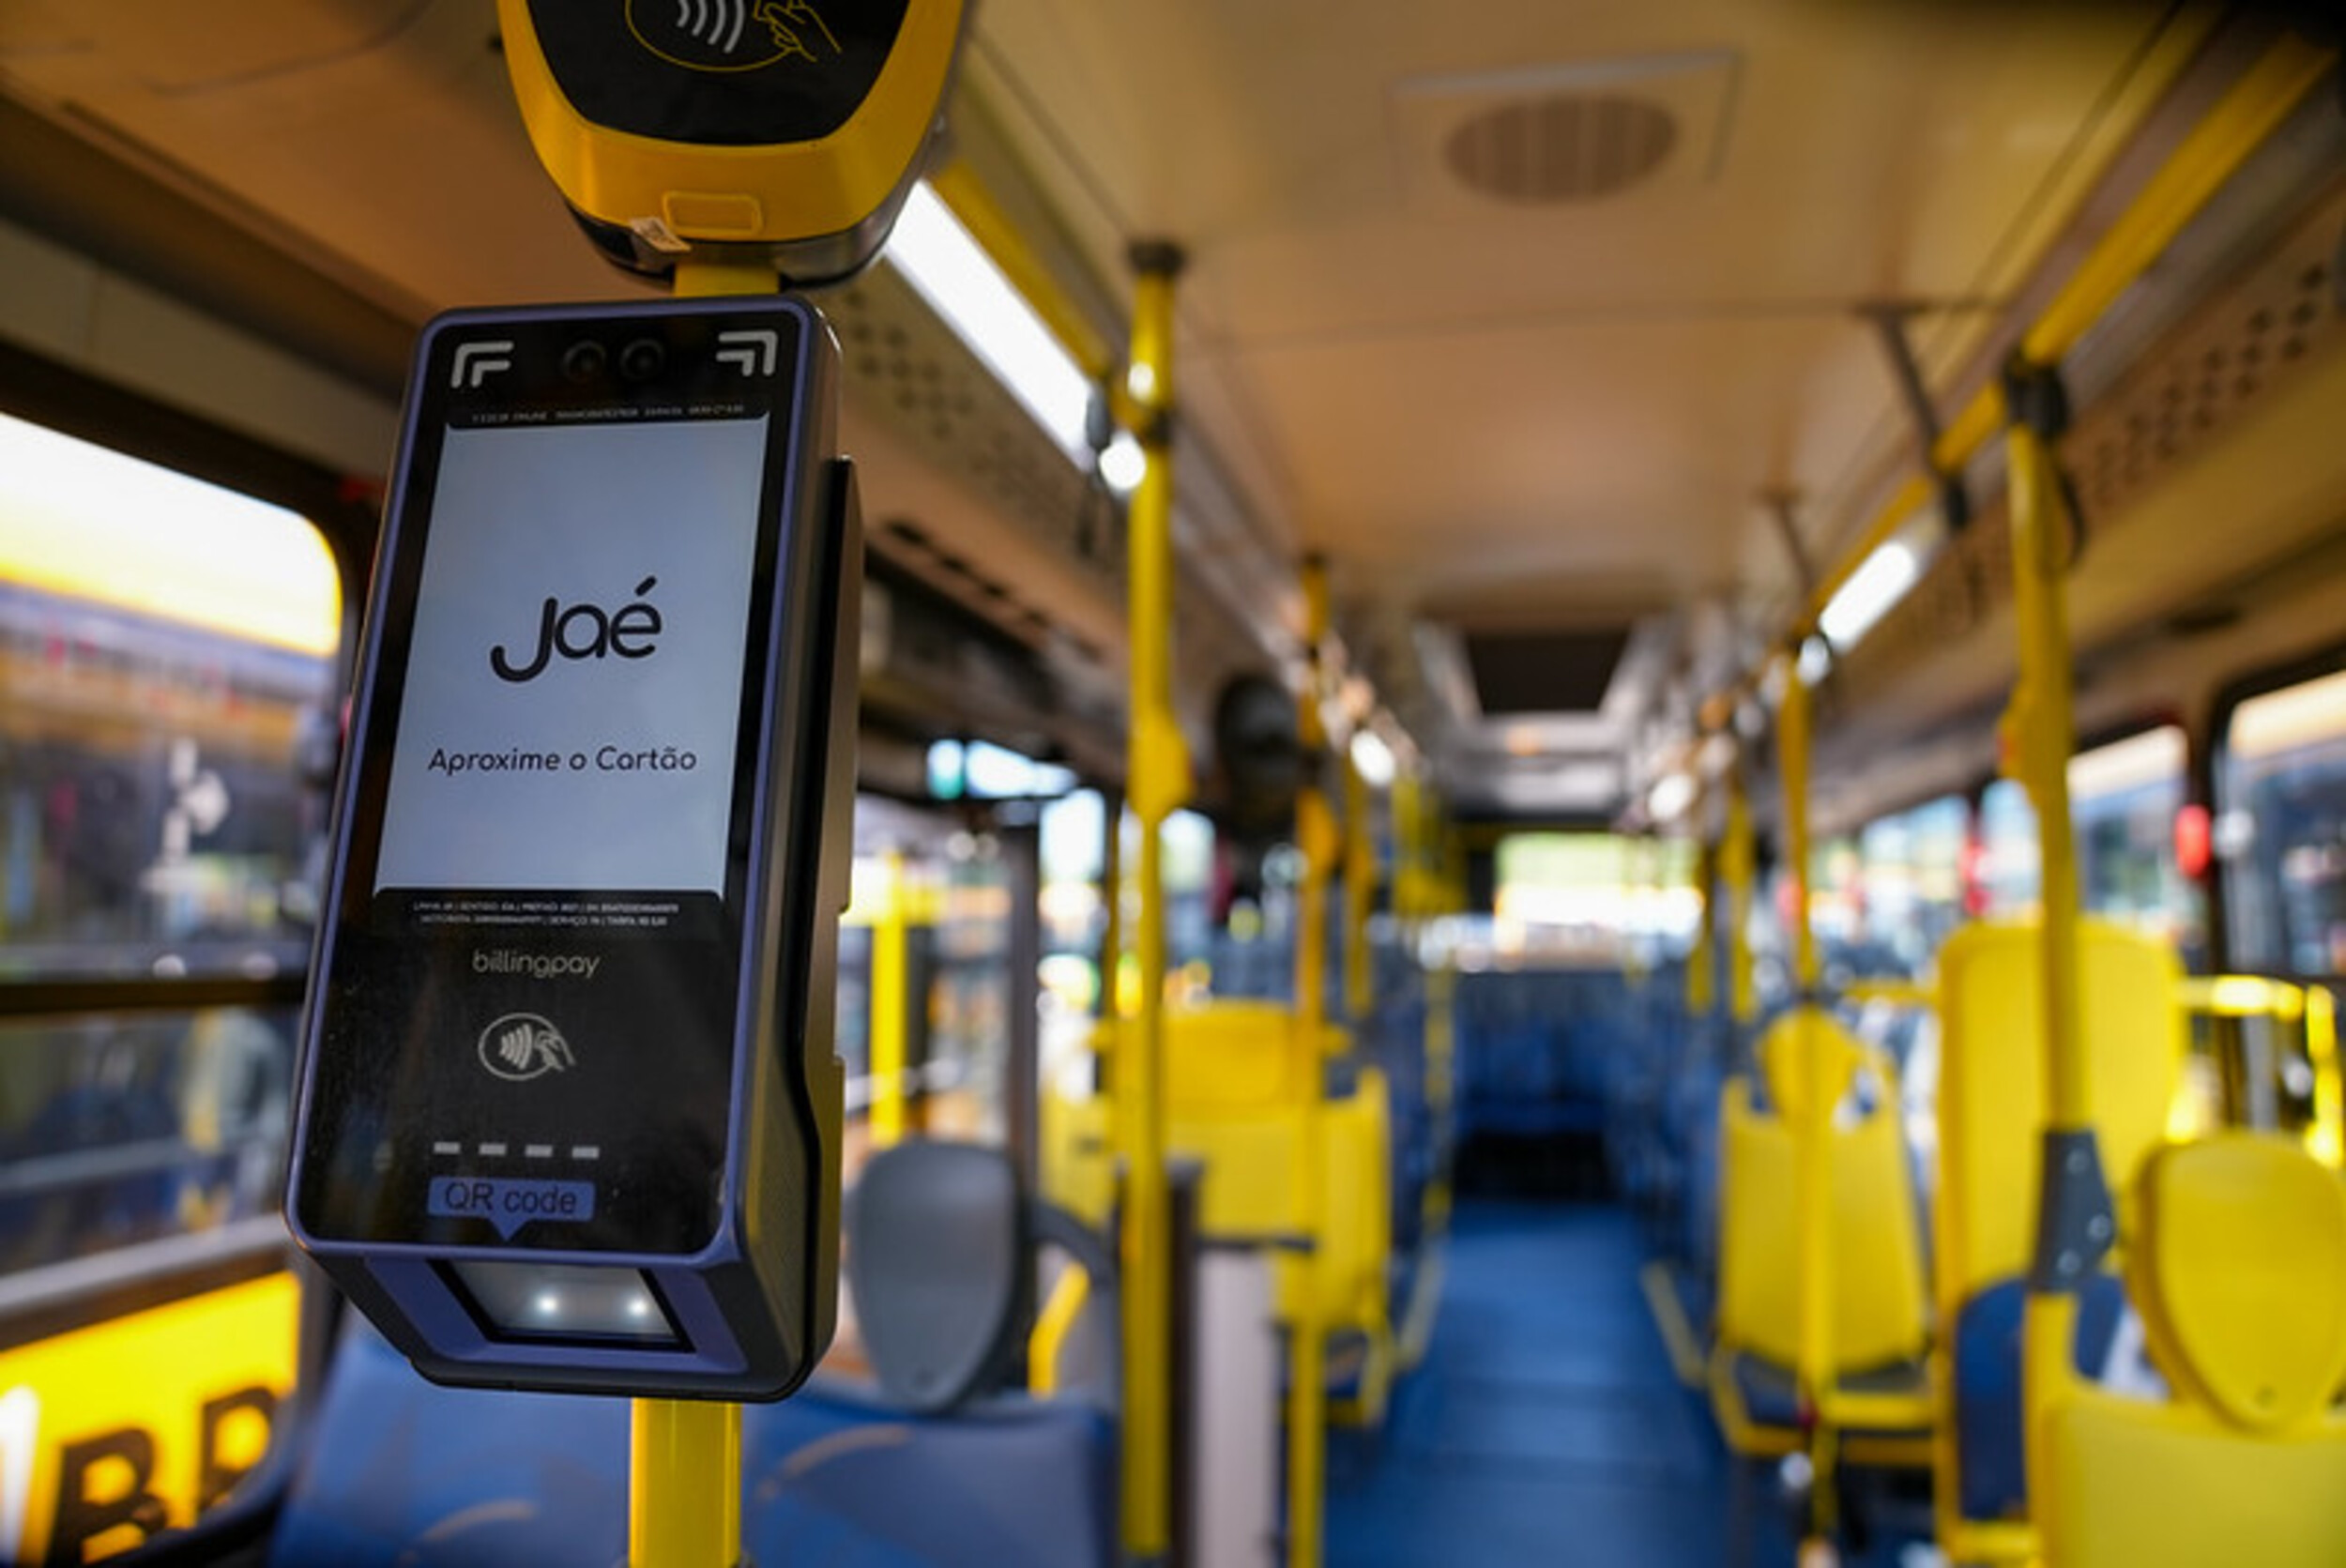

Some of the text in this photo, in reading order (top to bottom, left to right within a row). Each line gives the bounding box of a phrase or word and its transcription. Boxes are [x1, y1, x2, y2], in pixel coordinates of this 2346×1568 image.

[491, 575, 663, 683] Jaé
[428, 745, 697, 775] Aproxime o Cartão
[473, 949, 601, 978] billingpay
[445, 1181, 577, 1214] QR code
